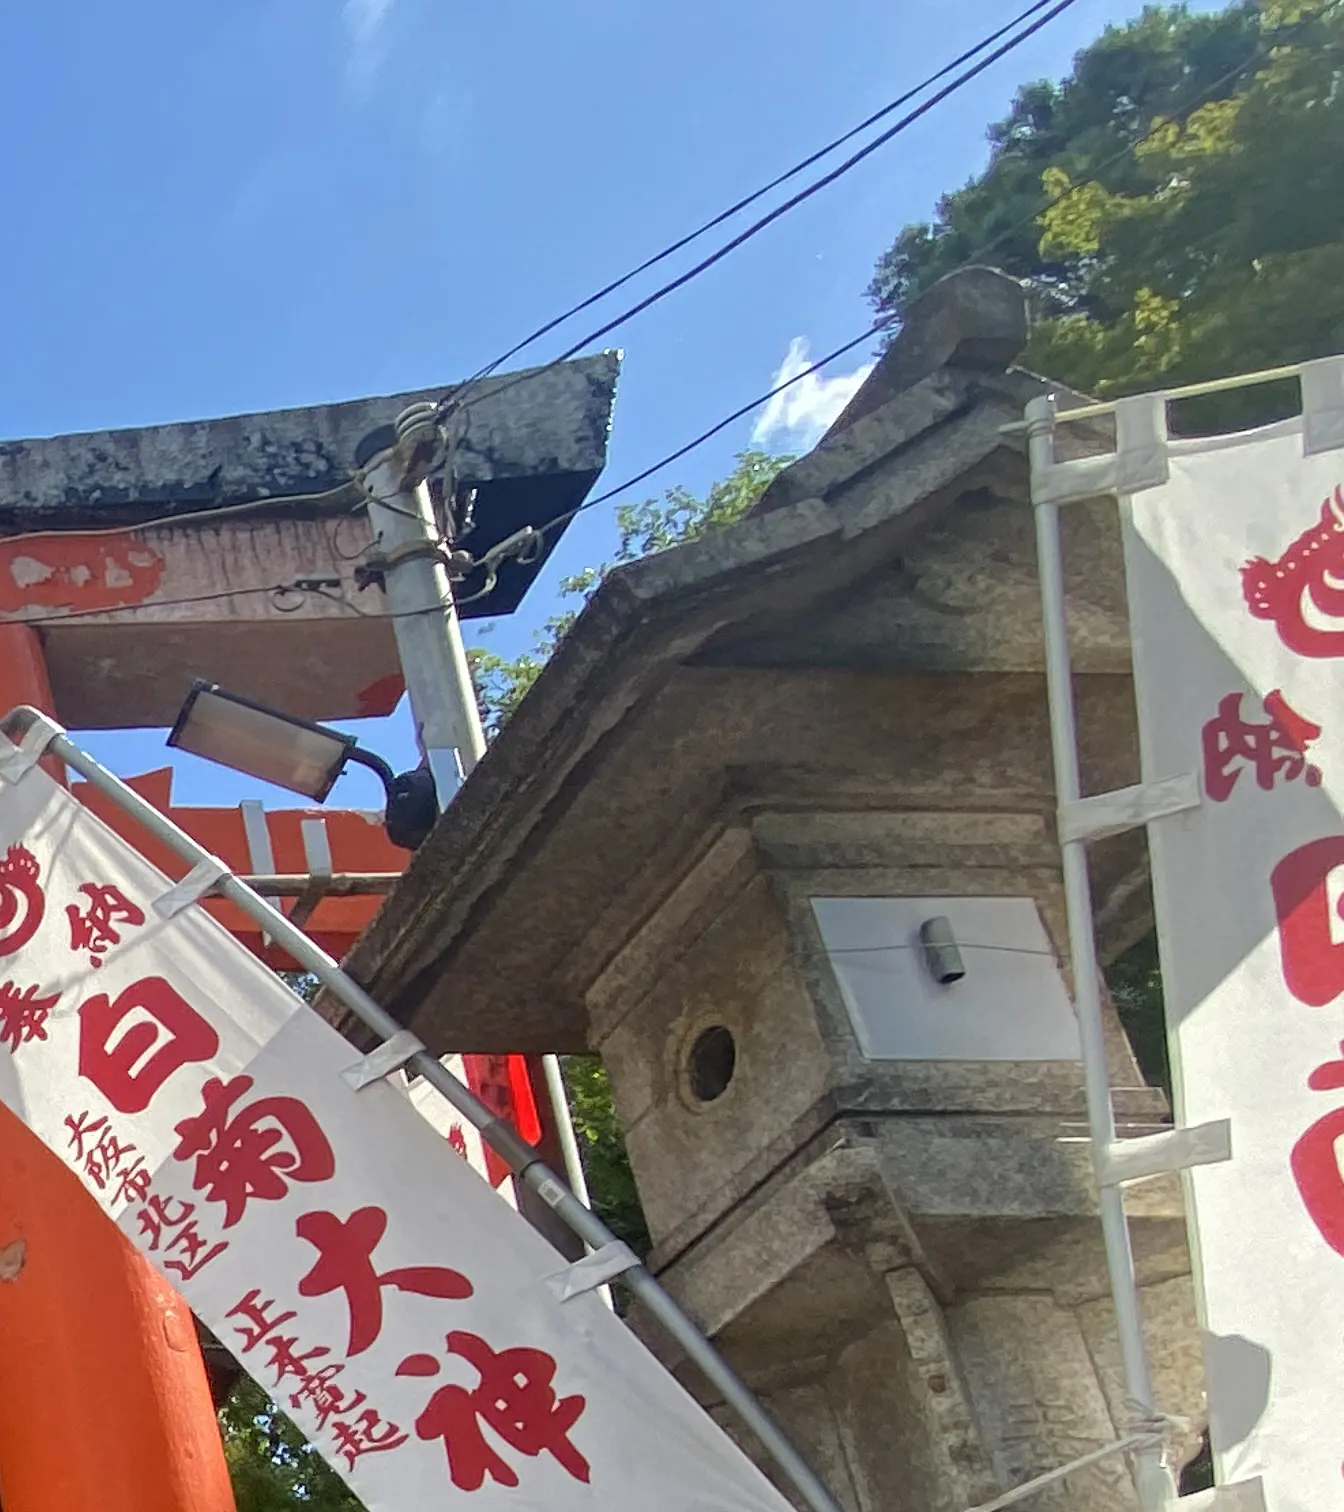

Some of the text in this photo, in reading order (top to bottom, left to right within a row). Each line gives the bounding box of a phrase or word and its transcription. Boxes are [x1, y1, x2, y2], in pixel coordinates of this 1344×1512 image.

[64, 1109, 229, 1281] 大阪市北区
[78, 975, 591, 1492] 白菊大神
